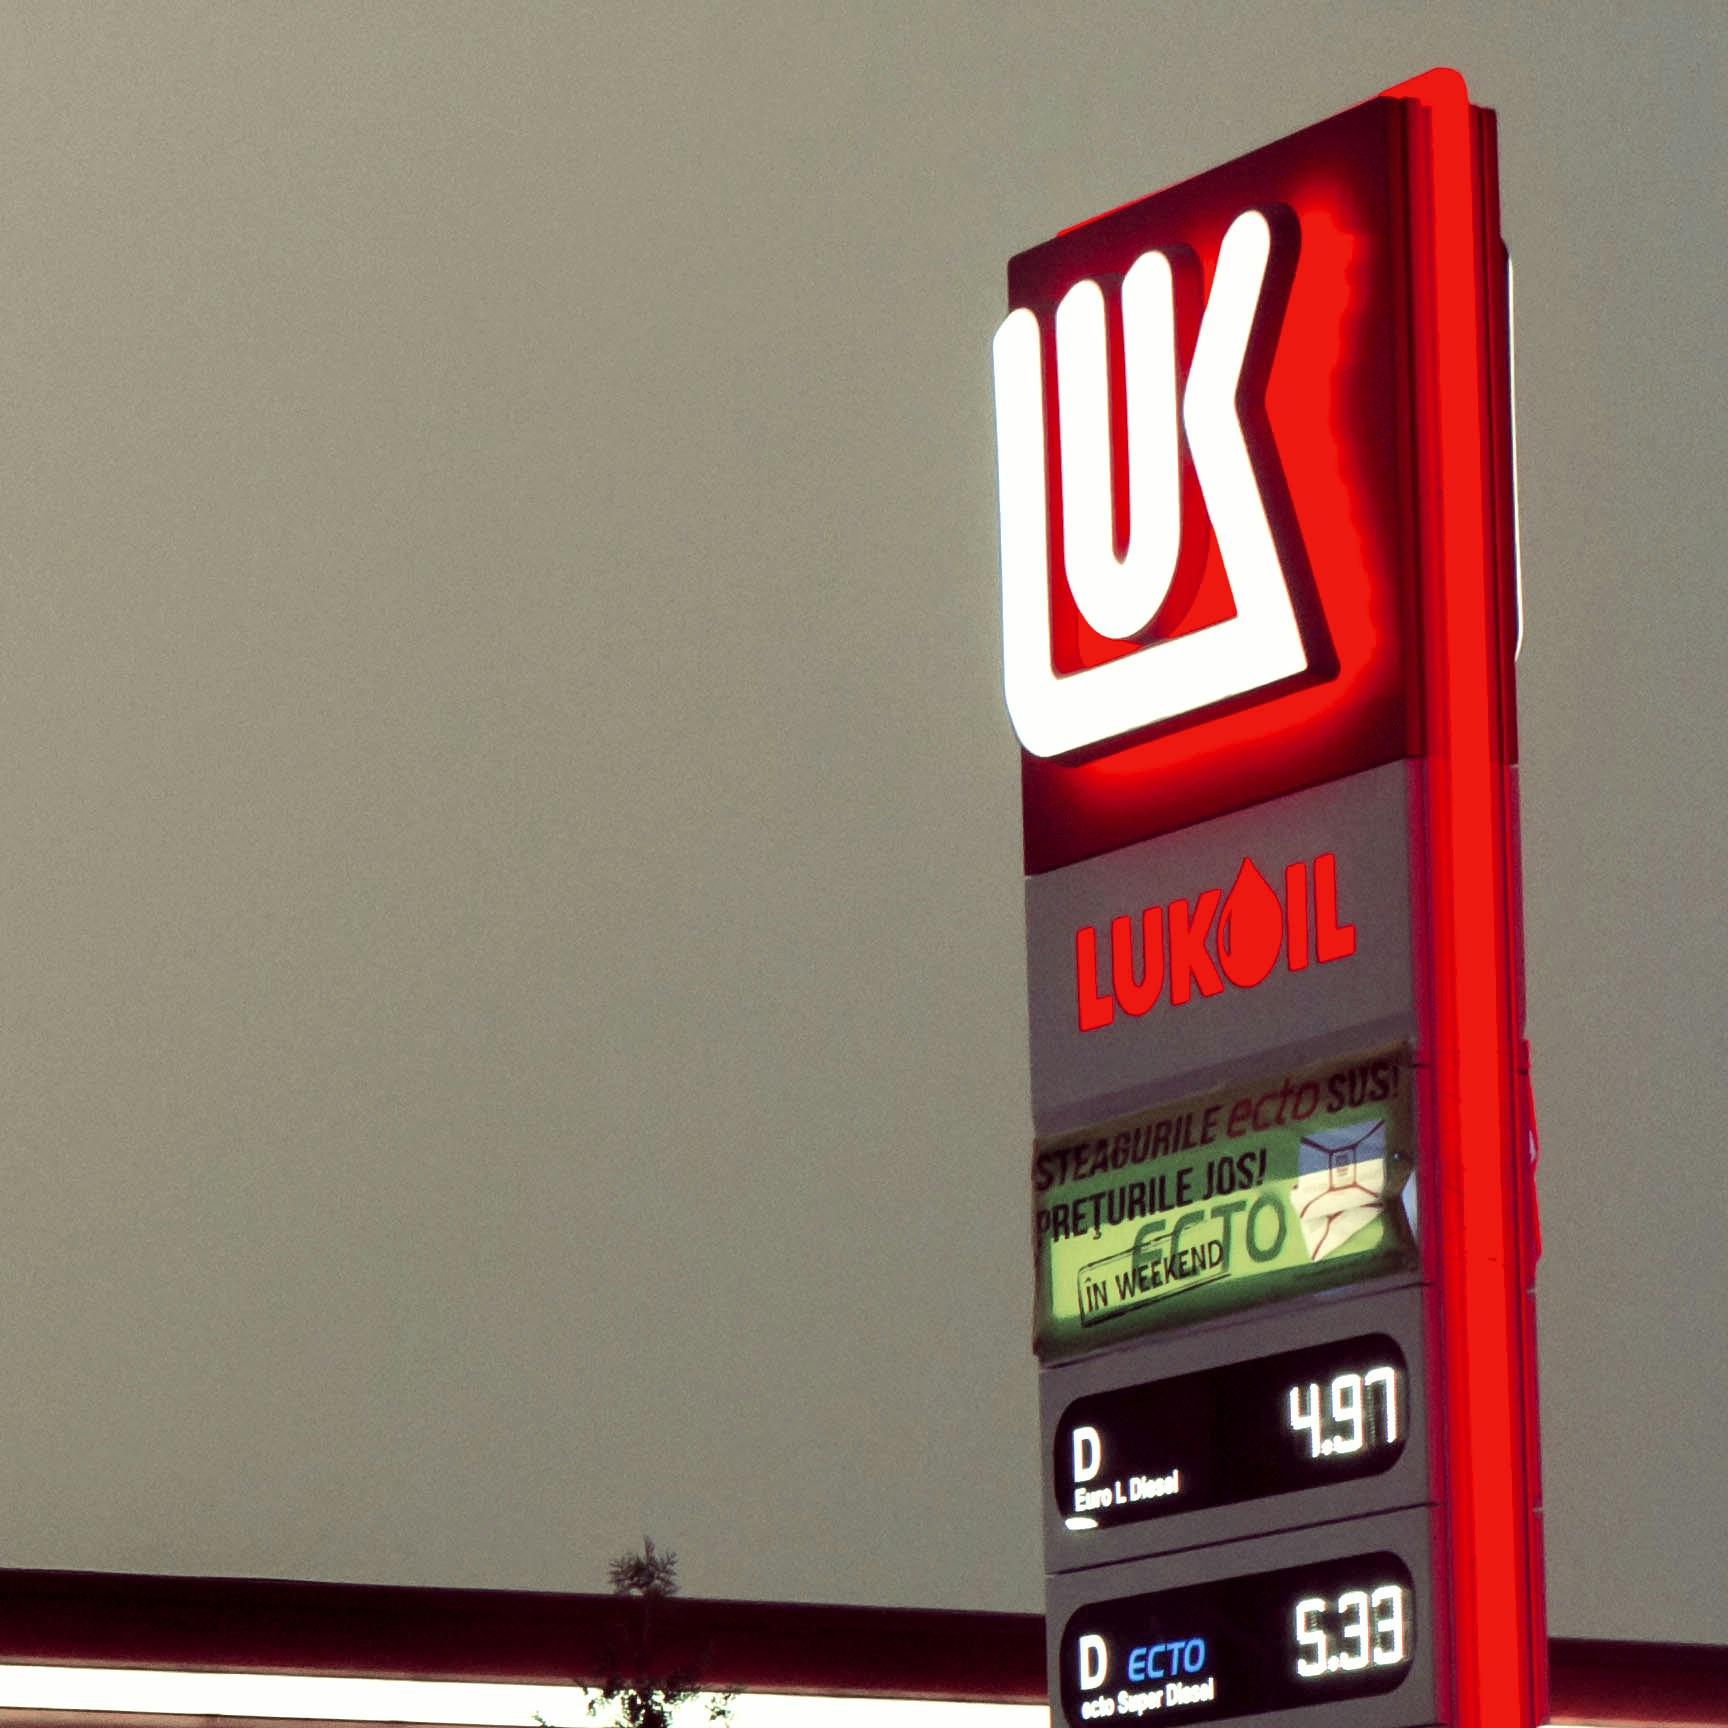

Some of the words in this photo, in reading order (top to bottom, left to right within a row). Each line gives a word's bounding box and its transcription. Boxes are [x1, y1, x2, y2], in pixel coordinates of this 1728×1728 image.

[992, 209, 1308, 758] LUK
[1075, 852, 1357, 1033] LUKOIL
[1034, 1104, 1223, 1192] STEAGURILE
[1226, 1078, 1320, 1140] ecto
[1326, 1061, 1401, 1114] SUS!
[1202, 1147, 1268, 1202] JOS!
[1116, 1239, 1224, 1302] WEEKEND
[1288, 1365, 1399, 1459] 4.97
[1072, 1426, 1102, 1483] D
[1074, 1484, 1113, 1513] Euro
[1116, 1481, 1128, 1505] L
[1130, 1469, 1181, 1499] Diesel
[1079, 1634, 1109, 1692] D
[1127, 1638, 1207, 1683] ECTO
[1295, 1585, 1404, 1678] 5.33
[1081, 1694, 1115, 1721] ecto
[1117, 1686, 1165, 1721] Super
[1166, 1677, 1215, 1707] Diesel
